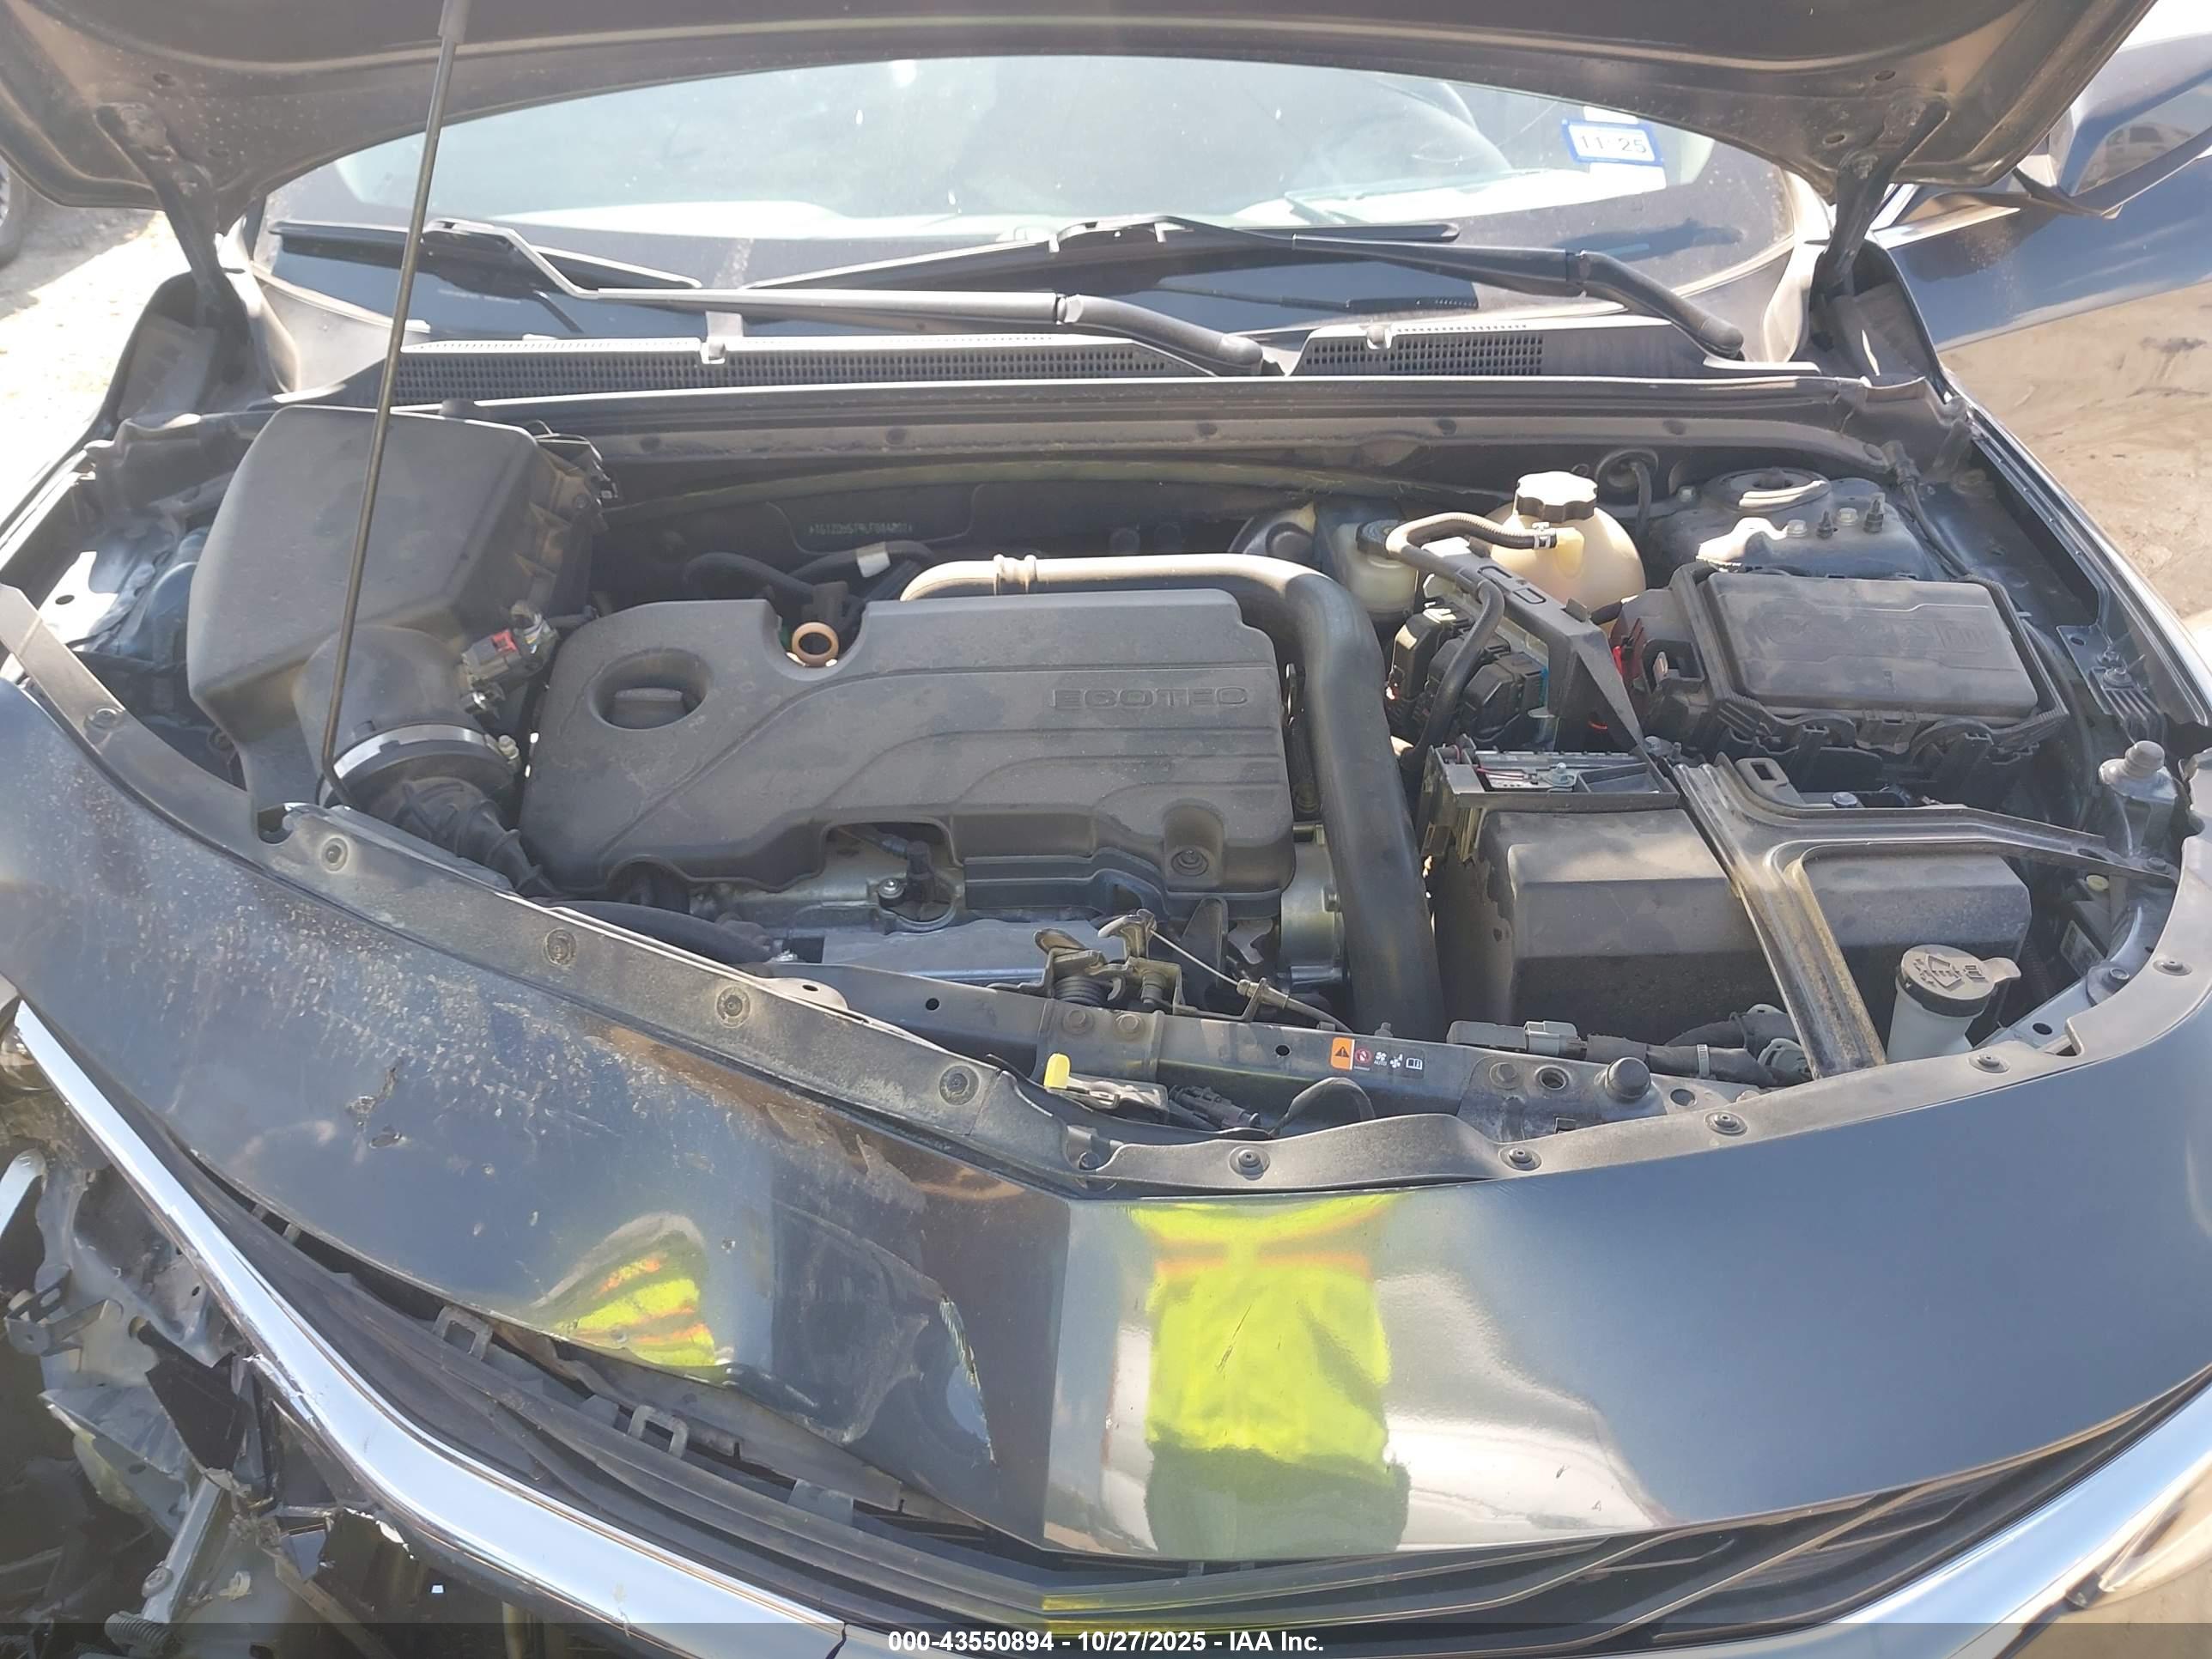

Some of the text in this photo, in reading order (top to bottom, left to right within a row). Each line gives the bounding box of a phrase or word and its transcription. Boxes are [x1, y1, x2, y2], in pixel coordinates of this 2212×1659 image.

[1582, 135, 1647, 154] 11 25
[1052, 687, 1249, 710] ECOTEC
